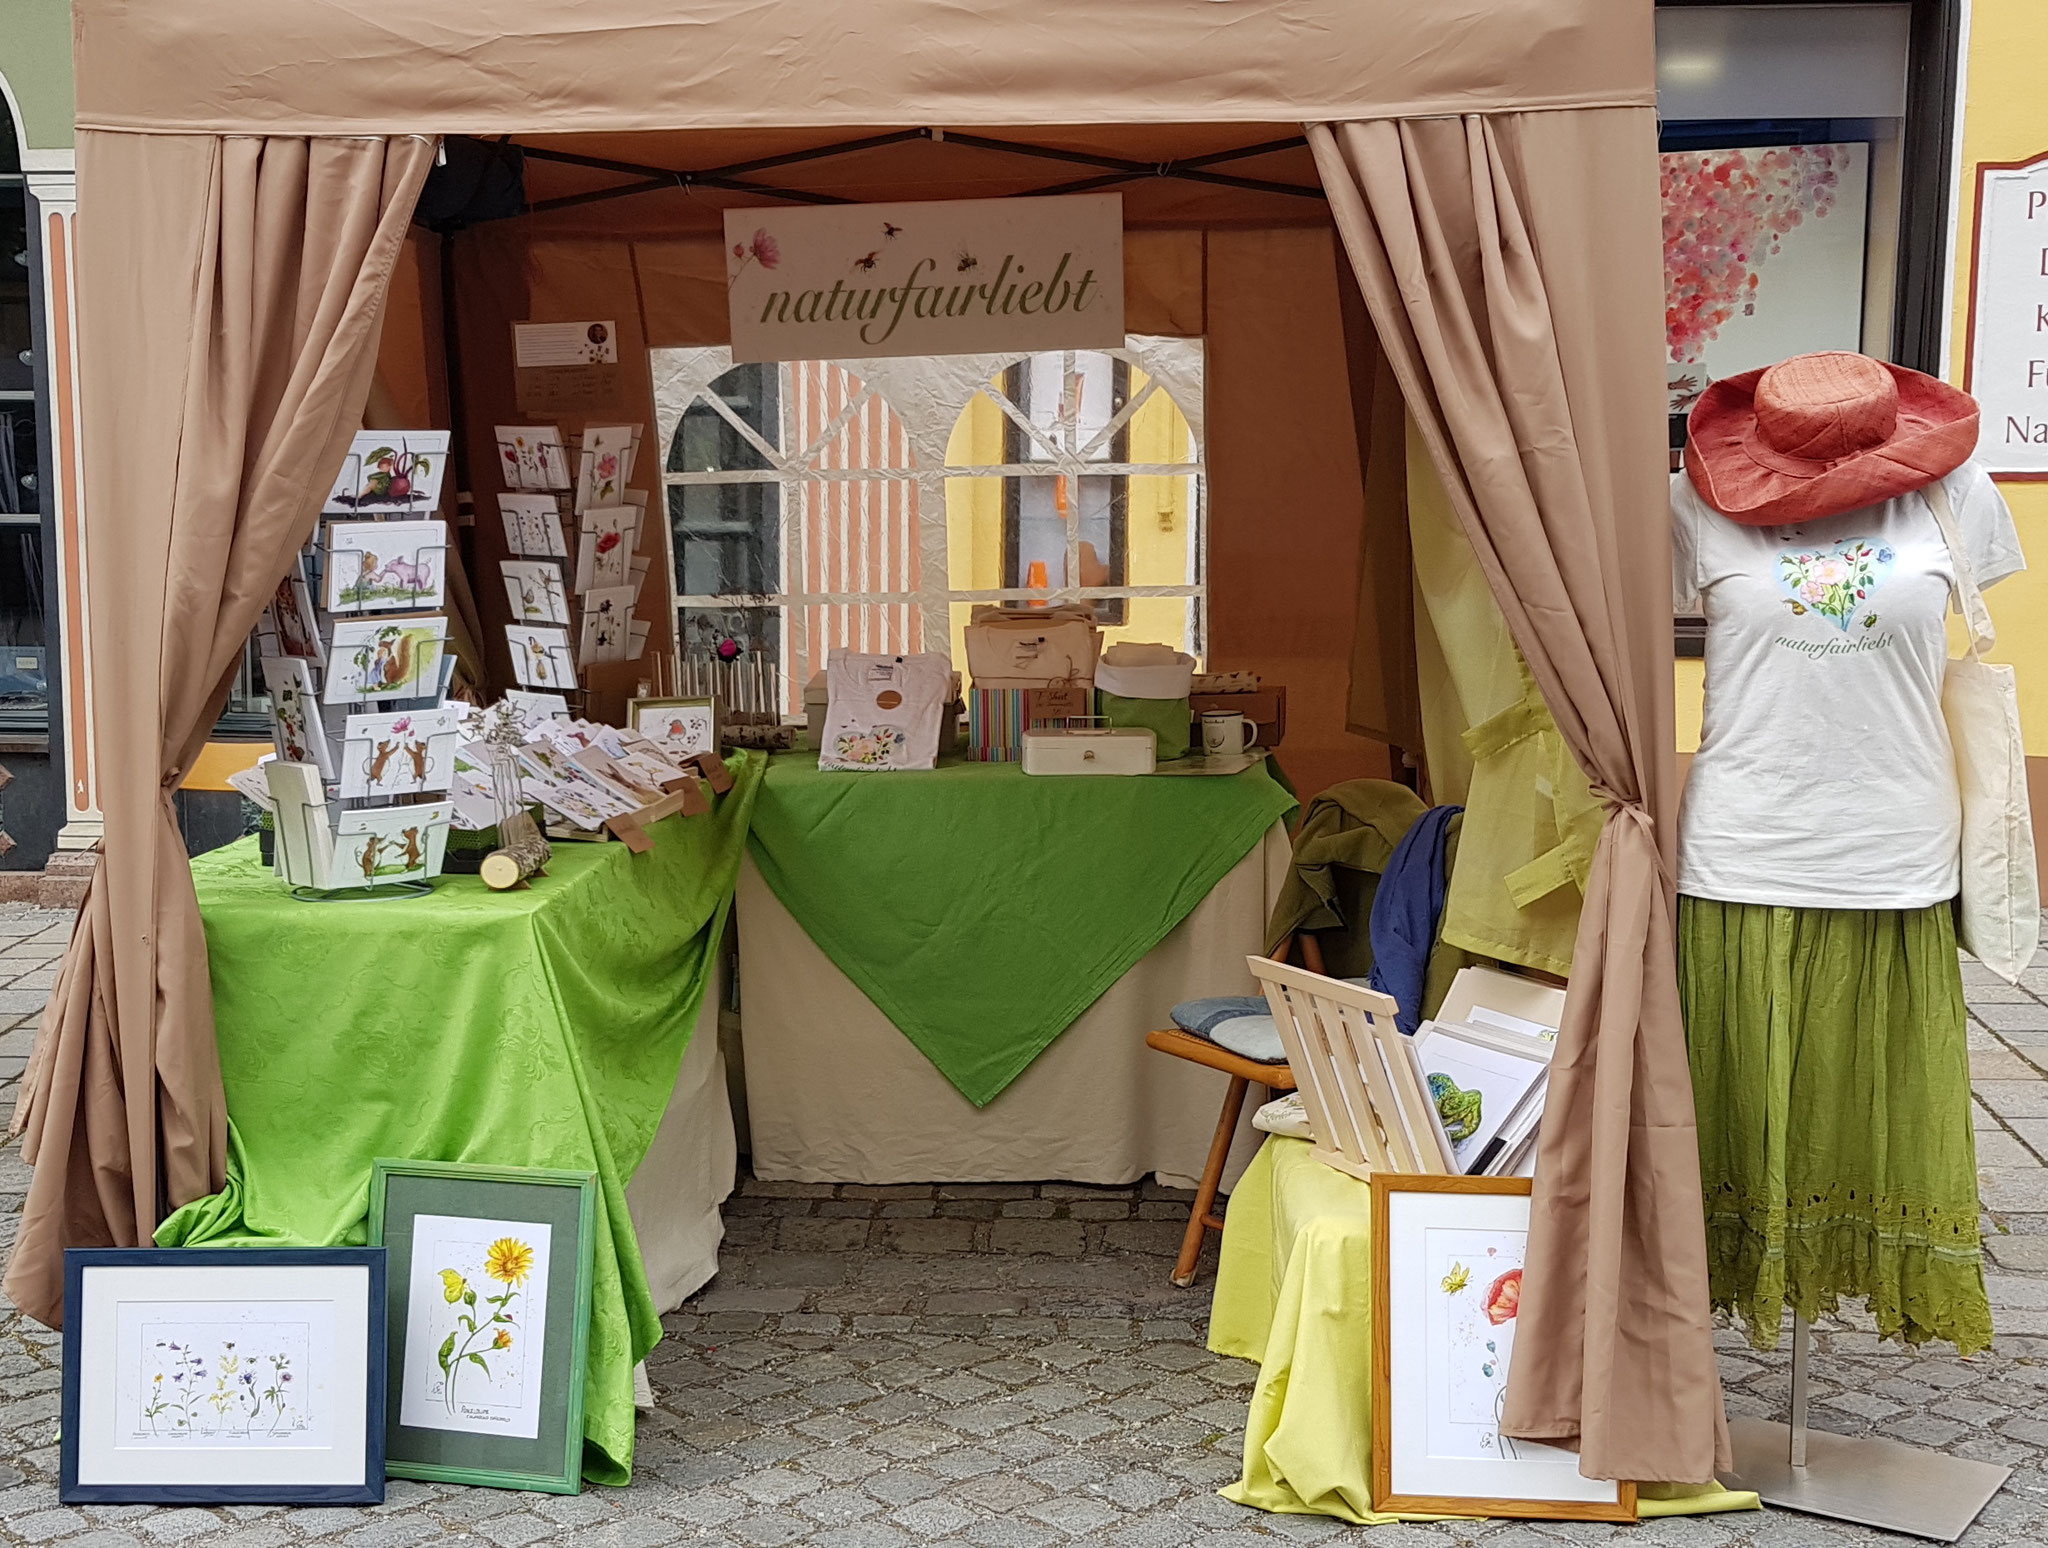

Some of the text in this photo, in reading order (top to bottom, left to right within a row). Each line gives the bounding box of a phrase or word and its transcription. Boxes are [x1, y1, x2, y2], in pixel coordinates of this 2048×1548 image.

[2027, 190, 2048, 220] P
[760, 252, 1098, 346] naturfairliebt
[1775, 632, 1895, 660] naturfairliebt
